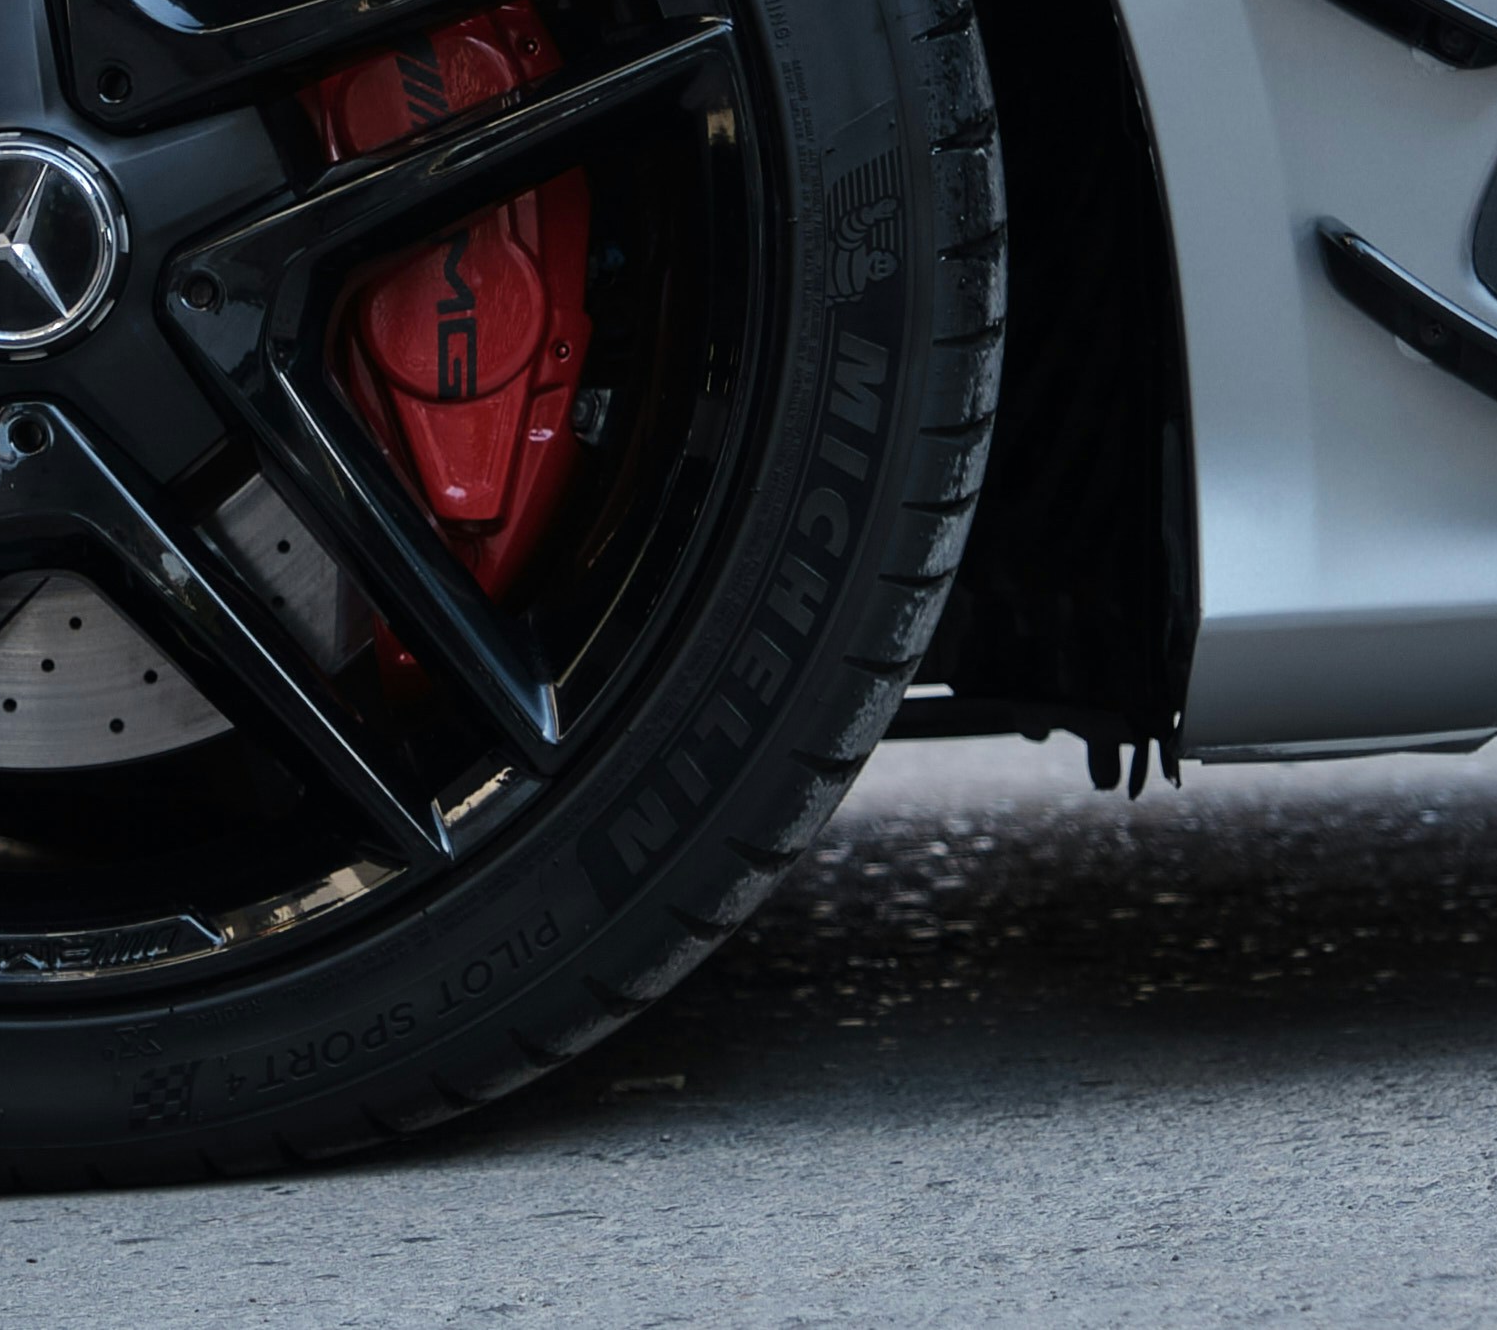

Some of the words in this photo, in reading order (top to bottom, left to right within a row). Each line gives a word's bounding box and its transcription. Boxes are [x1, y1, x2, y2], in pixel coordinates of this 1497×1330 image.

[437, 229, 477, 400] MG
[601, 333, 899, 877] MICHELIN
[422, 907, 570, 1020] PILOT
[221, 1068, 252, 1102] 4
[247, 997, 424, 1093] SPORT
